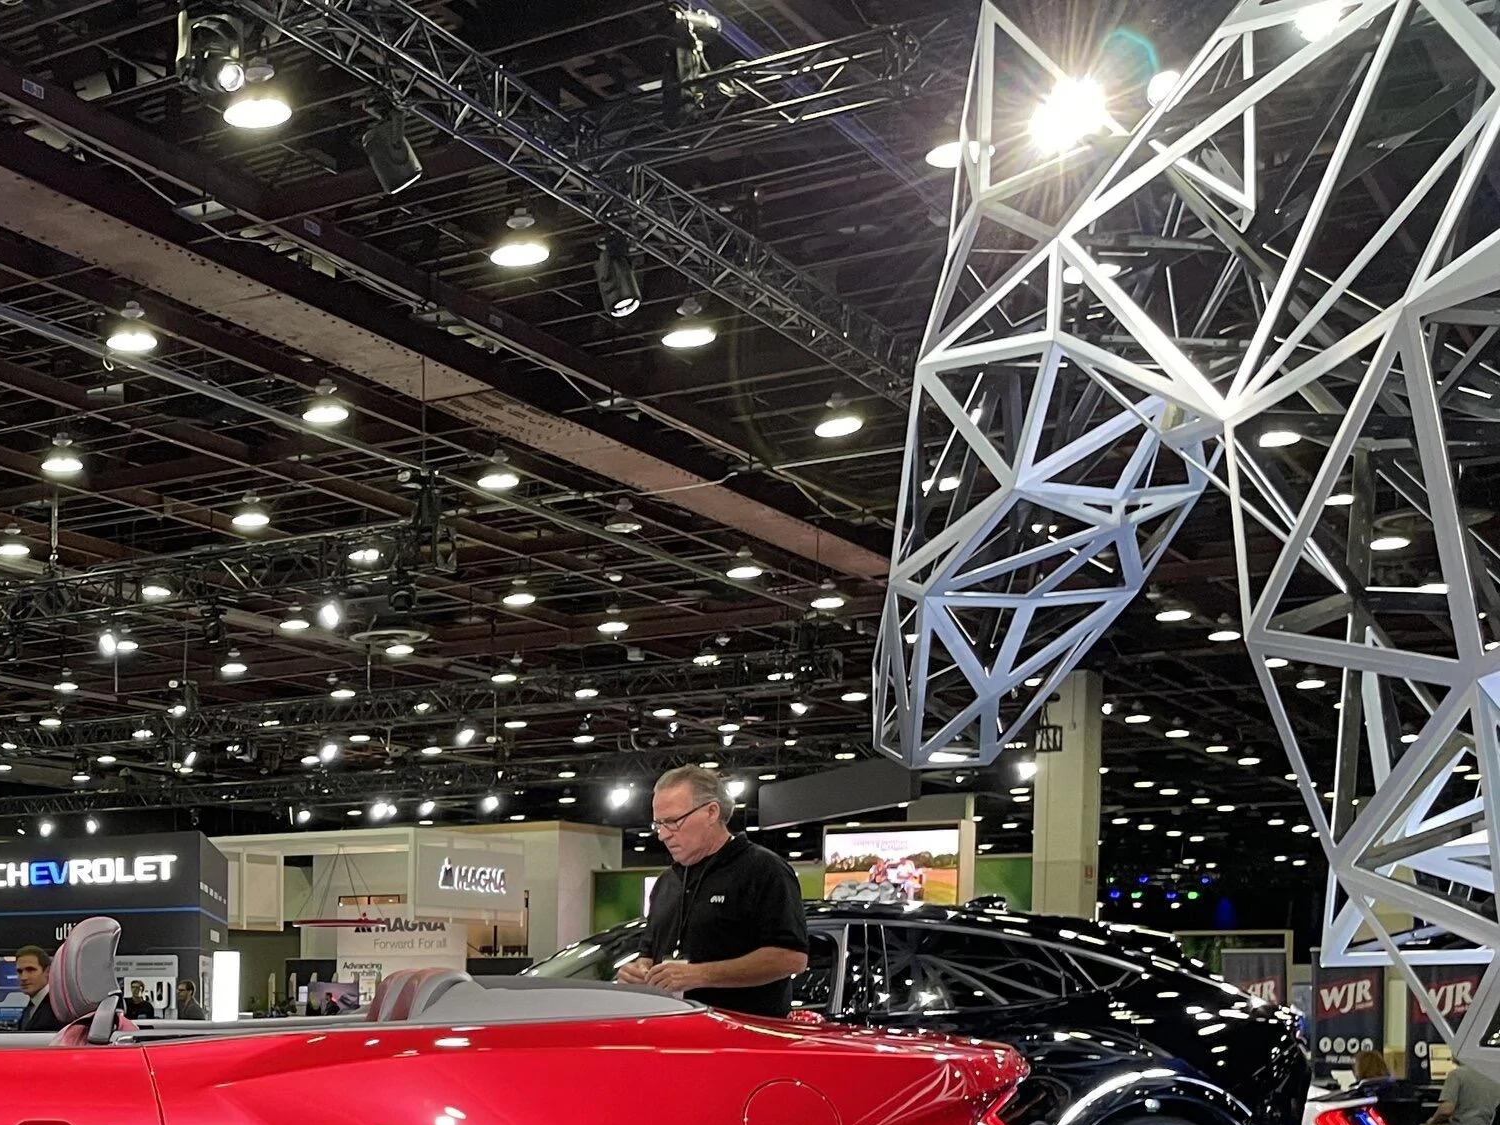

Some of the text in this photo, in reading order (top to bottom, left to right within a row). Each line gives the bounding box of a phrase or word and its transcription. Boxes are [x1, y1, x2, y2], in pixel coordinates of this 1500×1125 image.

[453, 865, 506, 894] MAGNA
[373, 938, 414, 949] Forward
[1320, 979, 1371, 1013] WJR
